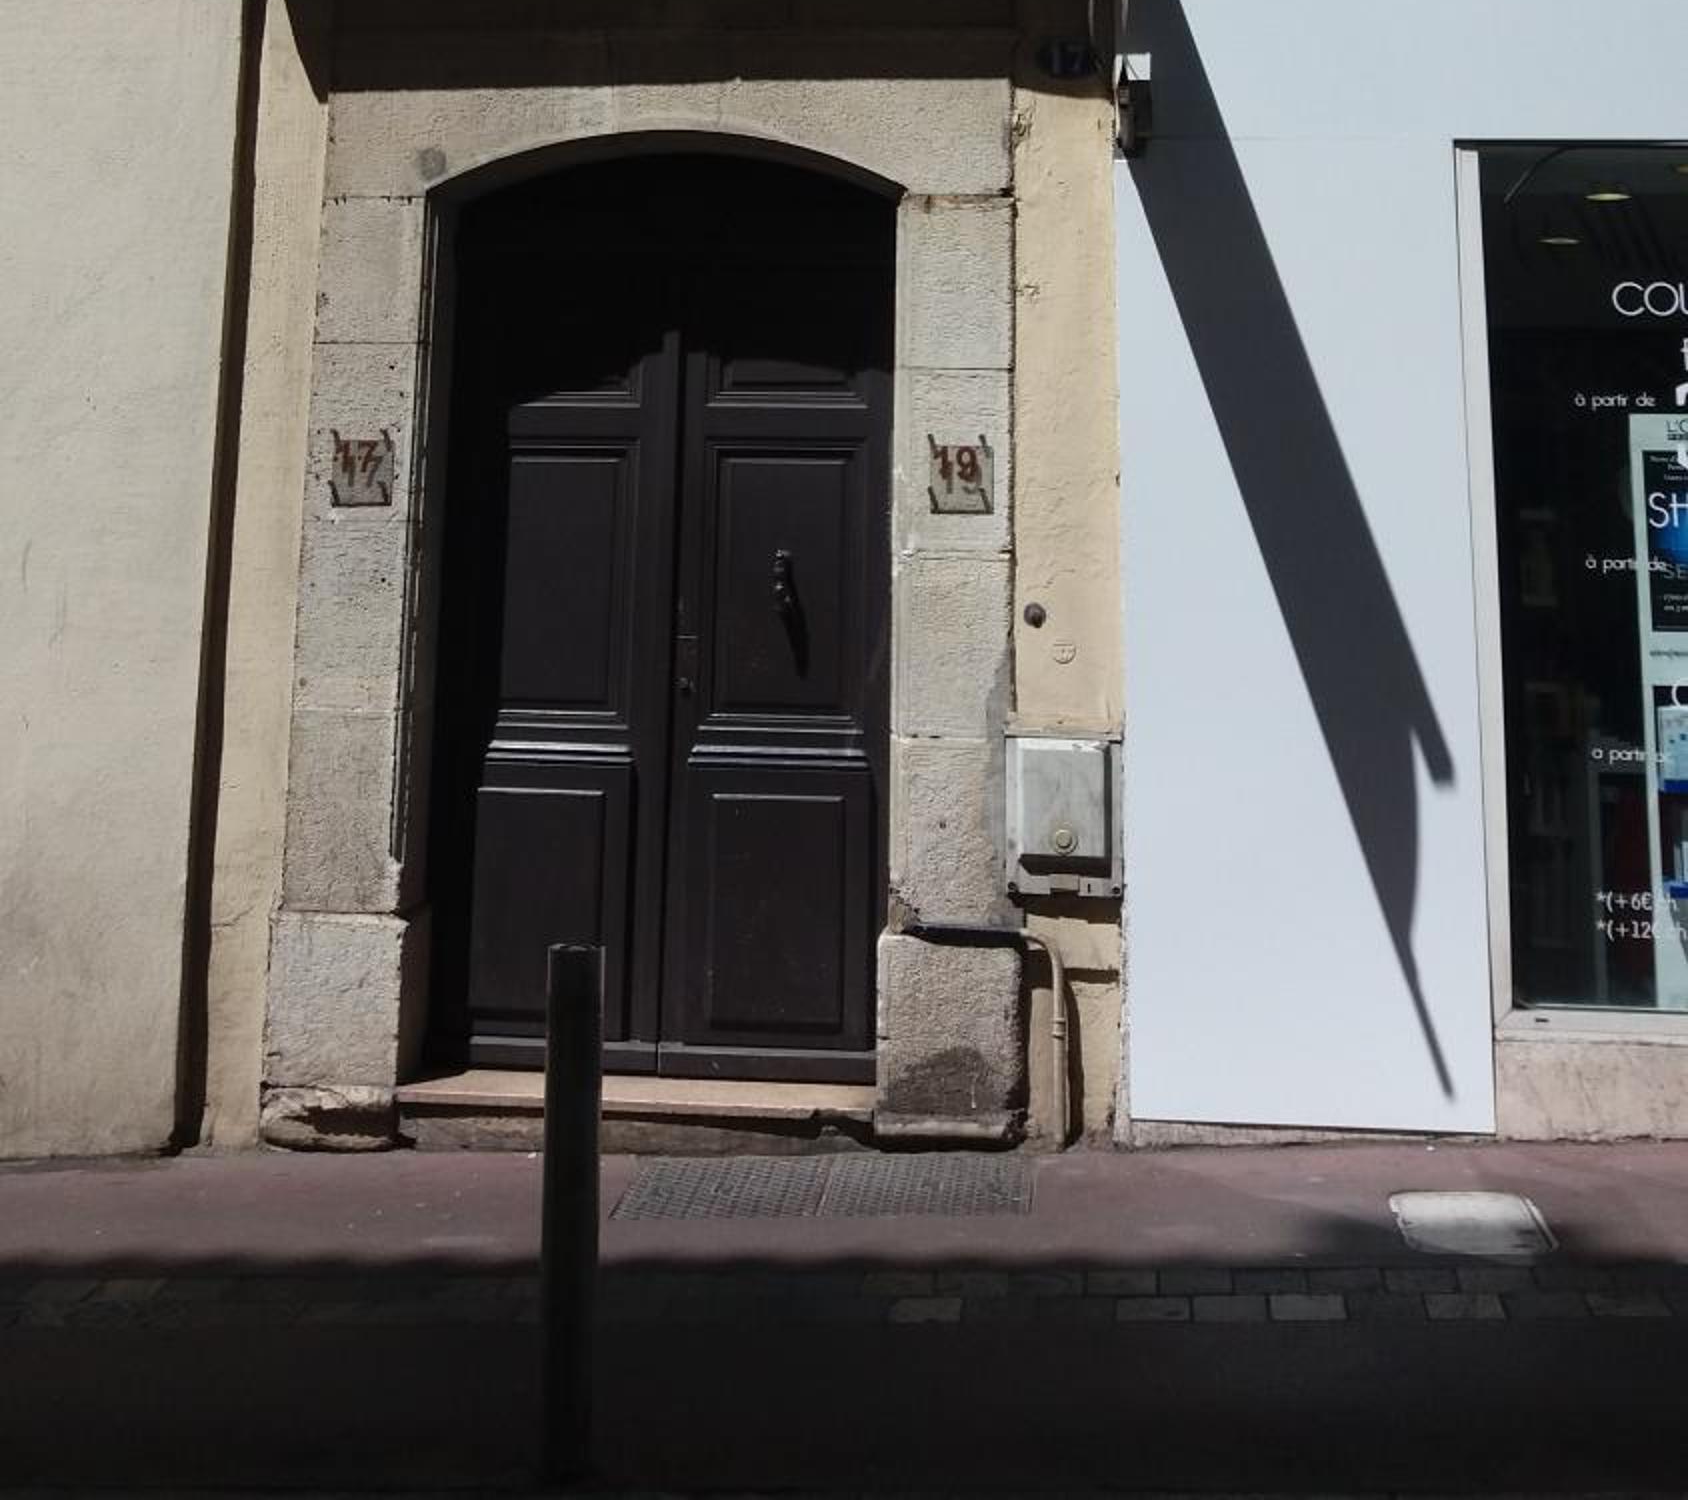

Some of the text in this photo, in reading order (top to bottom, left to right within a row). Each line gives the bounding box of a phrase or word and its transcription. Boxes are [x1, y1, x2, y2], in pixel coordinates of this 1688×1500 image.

[1591, 393, 1629, 411] partir
[1635, 392, 1656, 407] de
[335, 440, 380, 477] 17
[933, 446, 980, 485] 19
